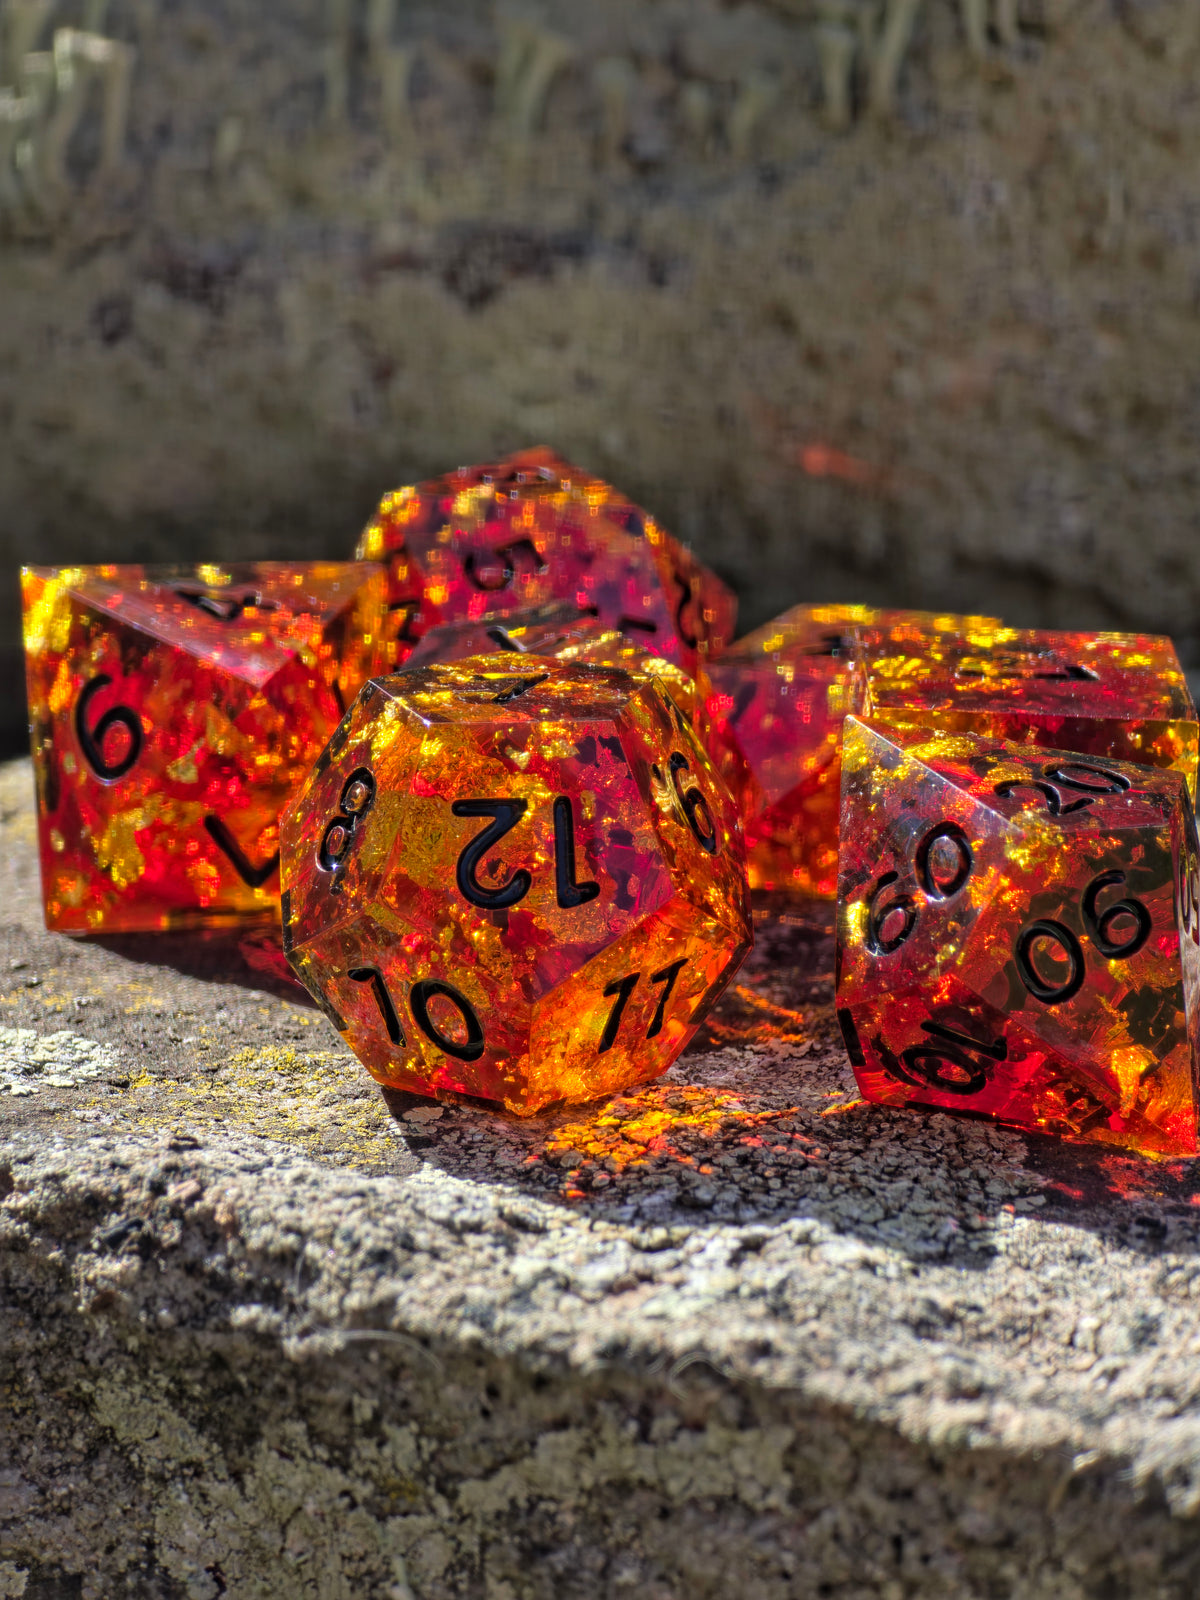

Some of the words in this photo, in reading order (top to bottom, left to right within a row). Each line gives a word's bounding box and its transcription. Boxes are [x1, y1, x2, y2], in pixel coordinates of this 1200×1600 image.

[75, 673, 144, 783] 6
[318, 766, 377, 873] 8
[452, 796, 600, 910] 12
[348, 966, 486, 1062] 10
[599, 957, 689, 1055] 11
